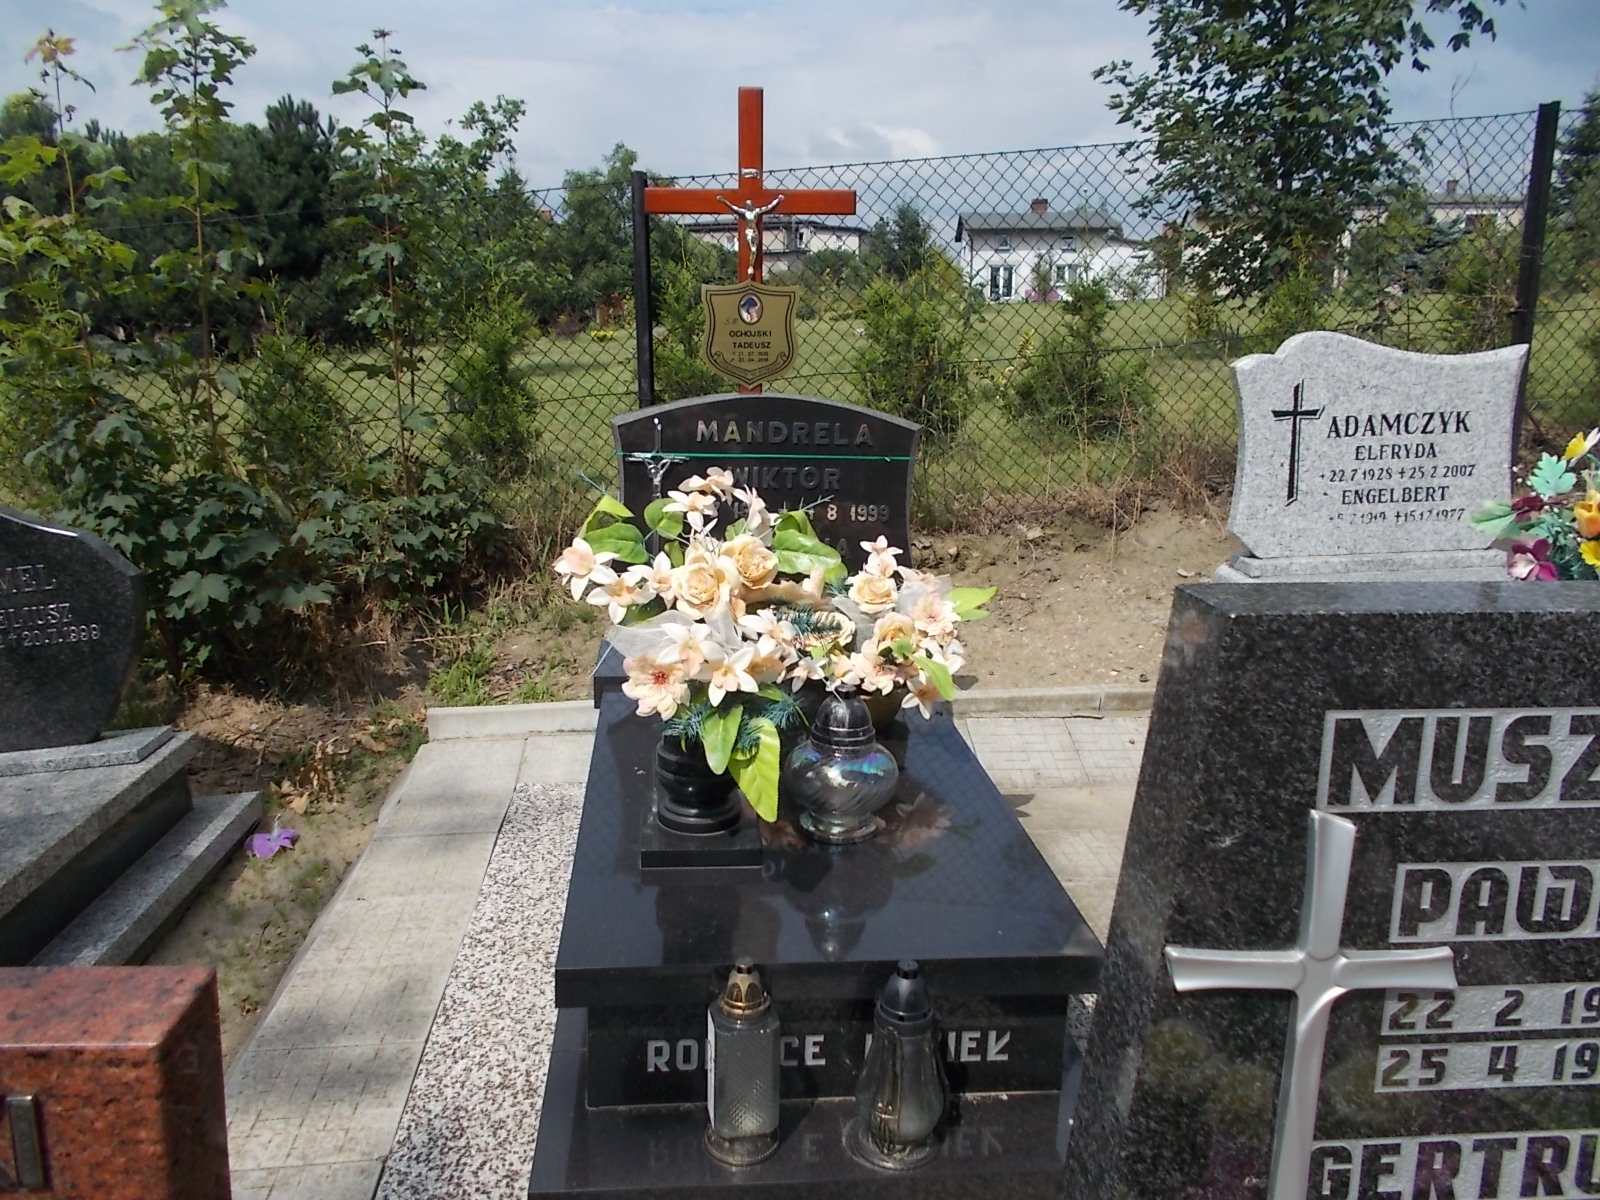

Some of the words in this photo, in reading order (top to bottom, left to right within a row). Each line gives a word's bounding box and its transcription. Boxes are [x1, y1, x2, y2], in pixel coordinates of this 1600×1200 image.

[729, 330, 772, 338] OCHOJSKI
[732, 341, 771, 349] TADEUSZ
[696, 419, 874, 446] MANDRELA
[1327, 410, 1471, 438] ADAMCZYK
[1354, 442, 1438, 461] ELFRYDA
[727, 465, 841, 490] WIKTOR
[1341, 485, 1450, 505] ENGELBERT
[1388, 990, 1456, 1030] 22
[1494, 989, 1524, 1027] 2
[1381, 1047, 1449, 1087] 25
[1486, 1045, 1520, 1082] 4
